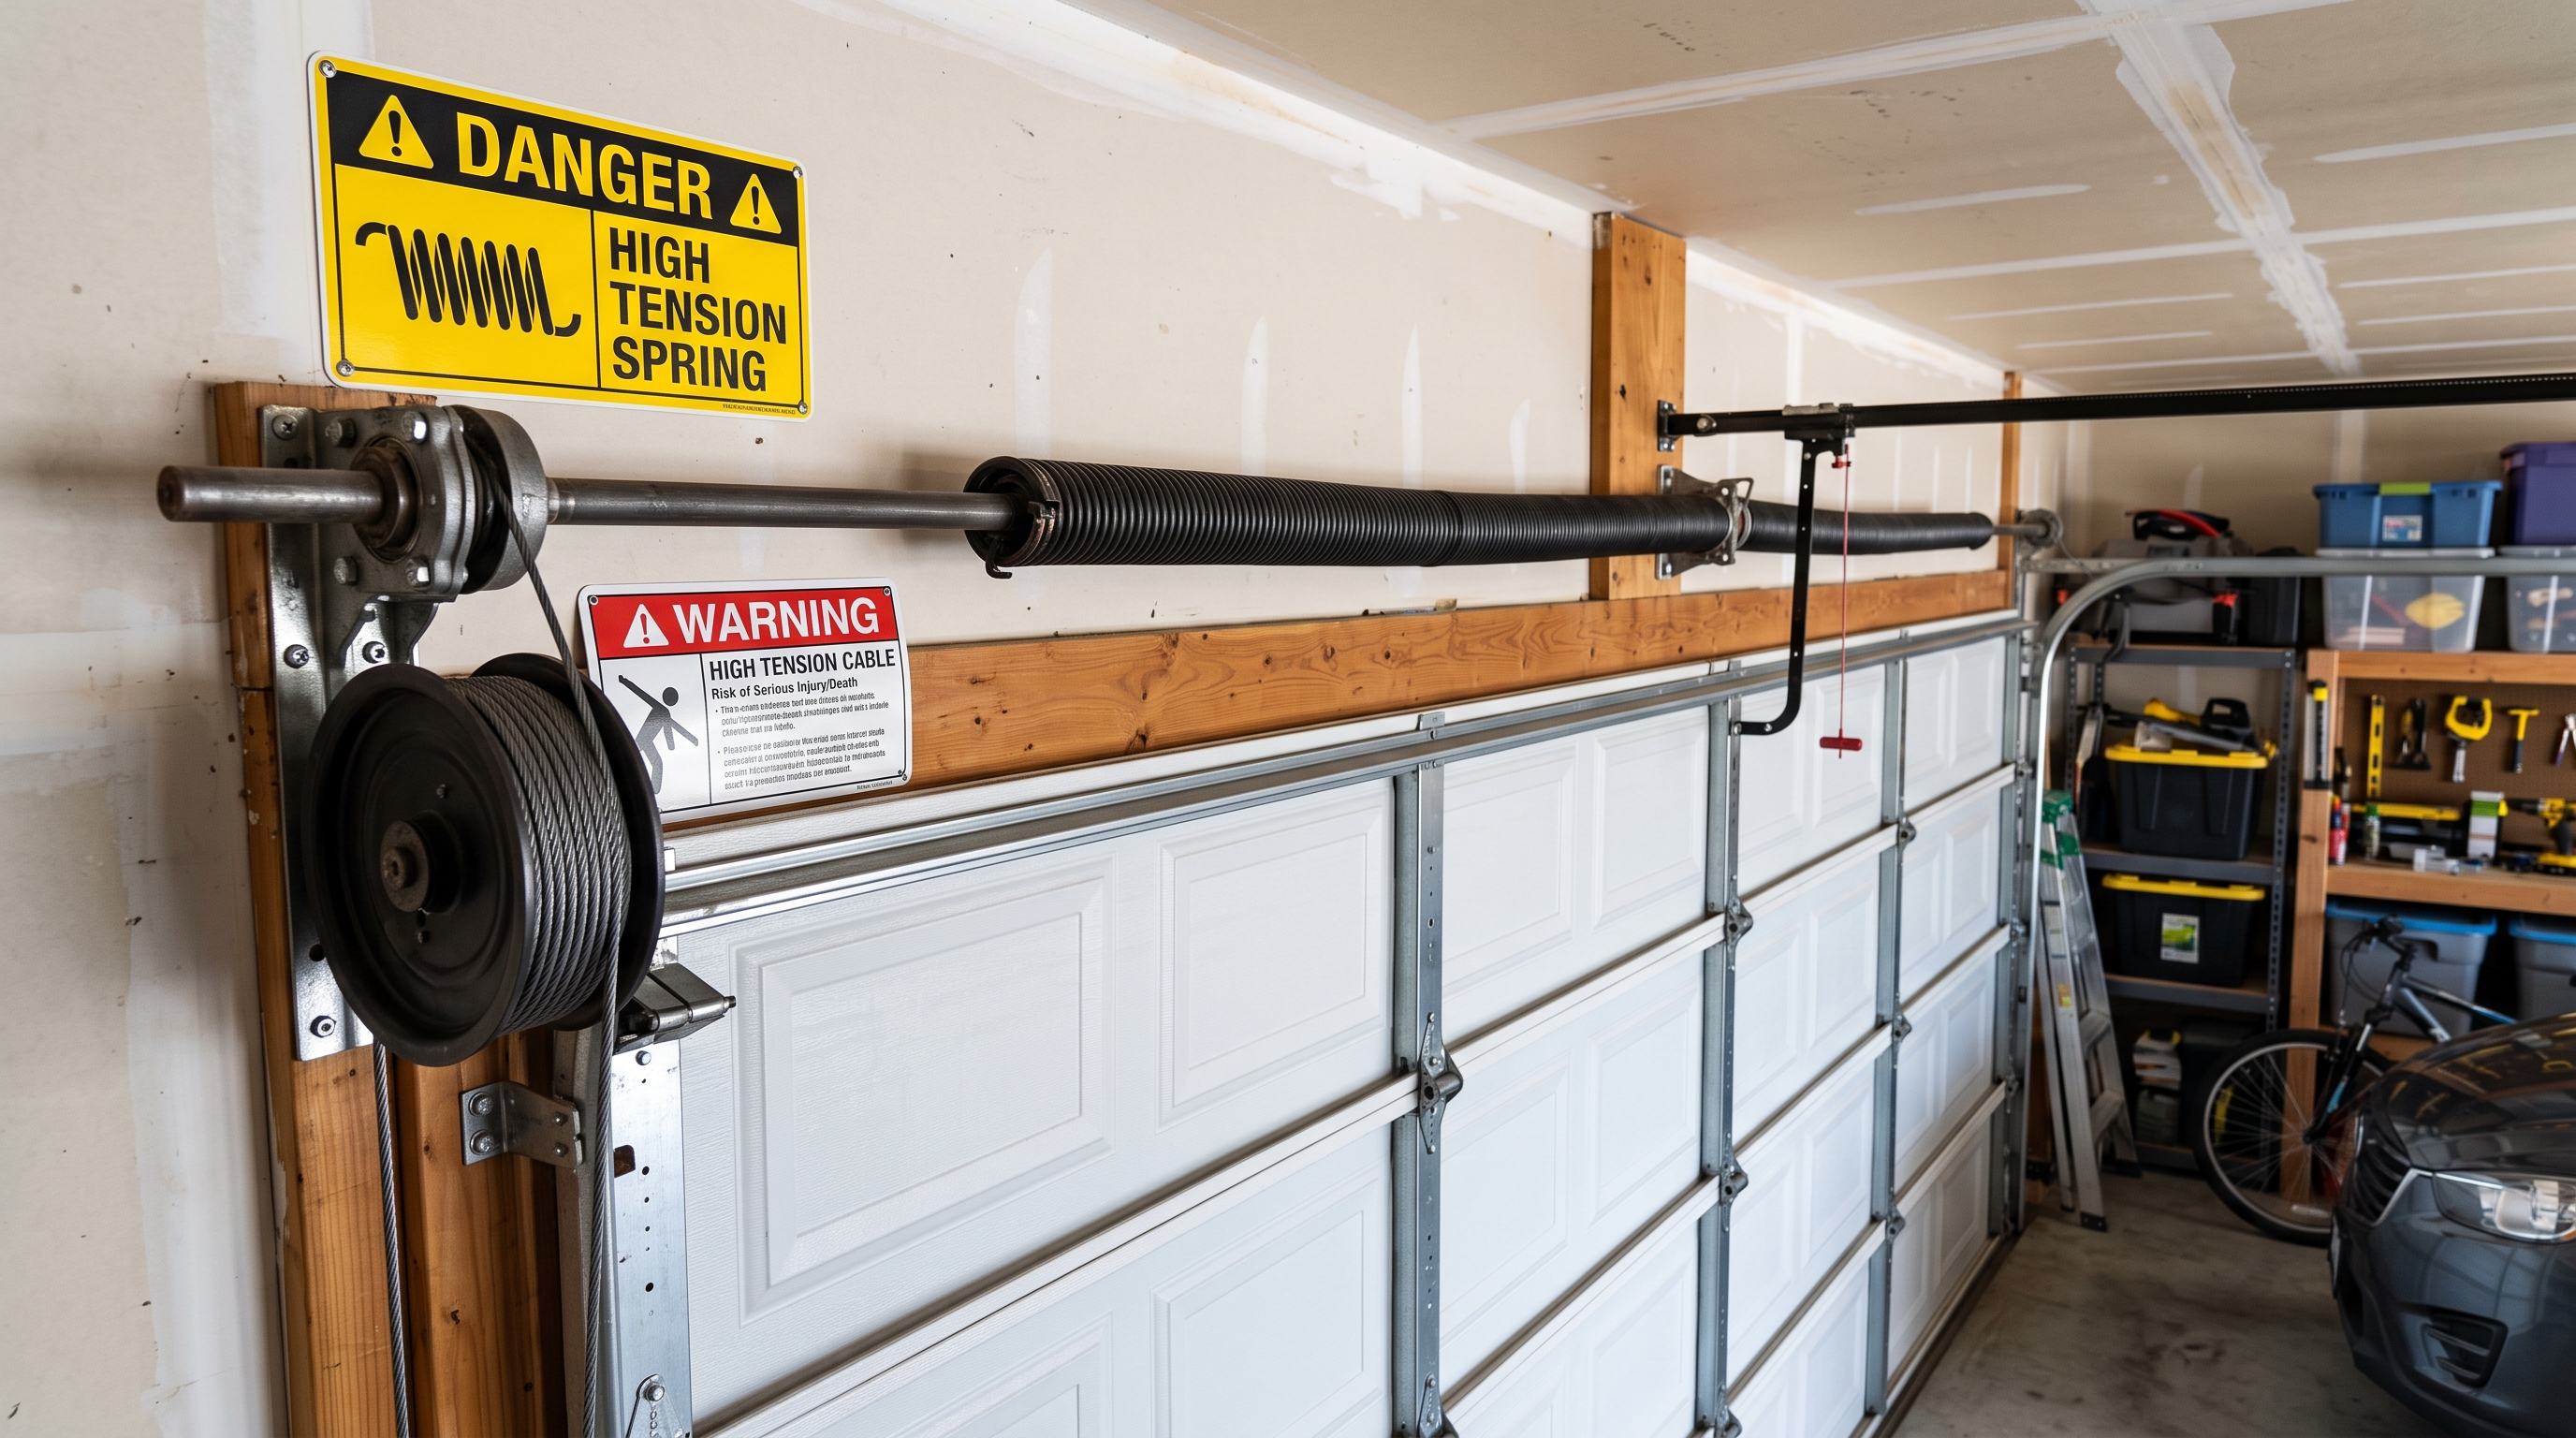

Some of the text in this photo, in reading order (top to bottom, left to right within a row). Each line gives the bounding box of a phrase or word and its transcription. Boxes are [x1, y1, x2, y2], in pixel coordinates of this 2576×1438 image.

[457, 111, 713, 220] DANGER
[609, 227, 710, 284] HIGH
[610, 281, 786, 345] TENSION
[612, 335, 766, 392] SPRING
[672, 597, 879, 643] WARNING
[709, 648, 896, 681] HIGH TENSION CABLE
[711, 677, 858, 700] Risk of Serious Injury/Death
